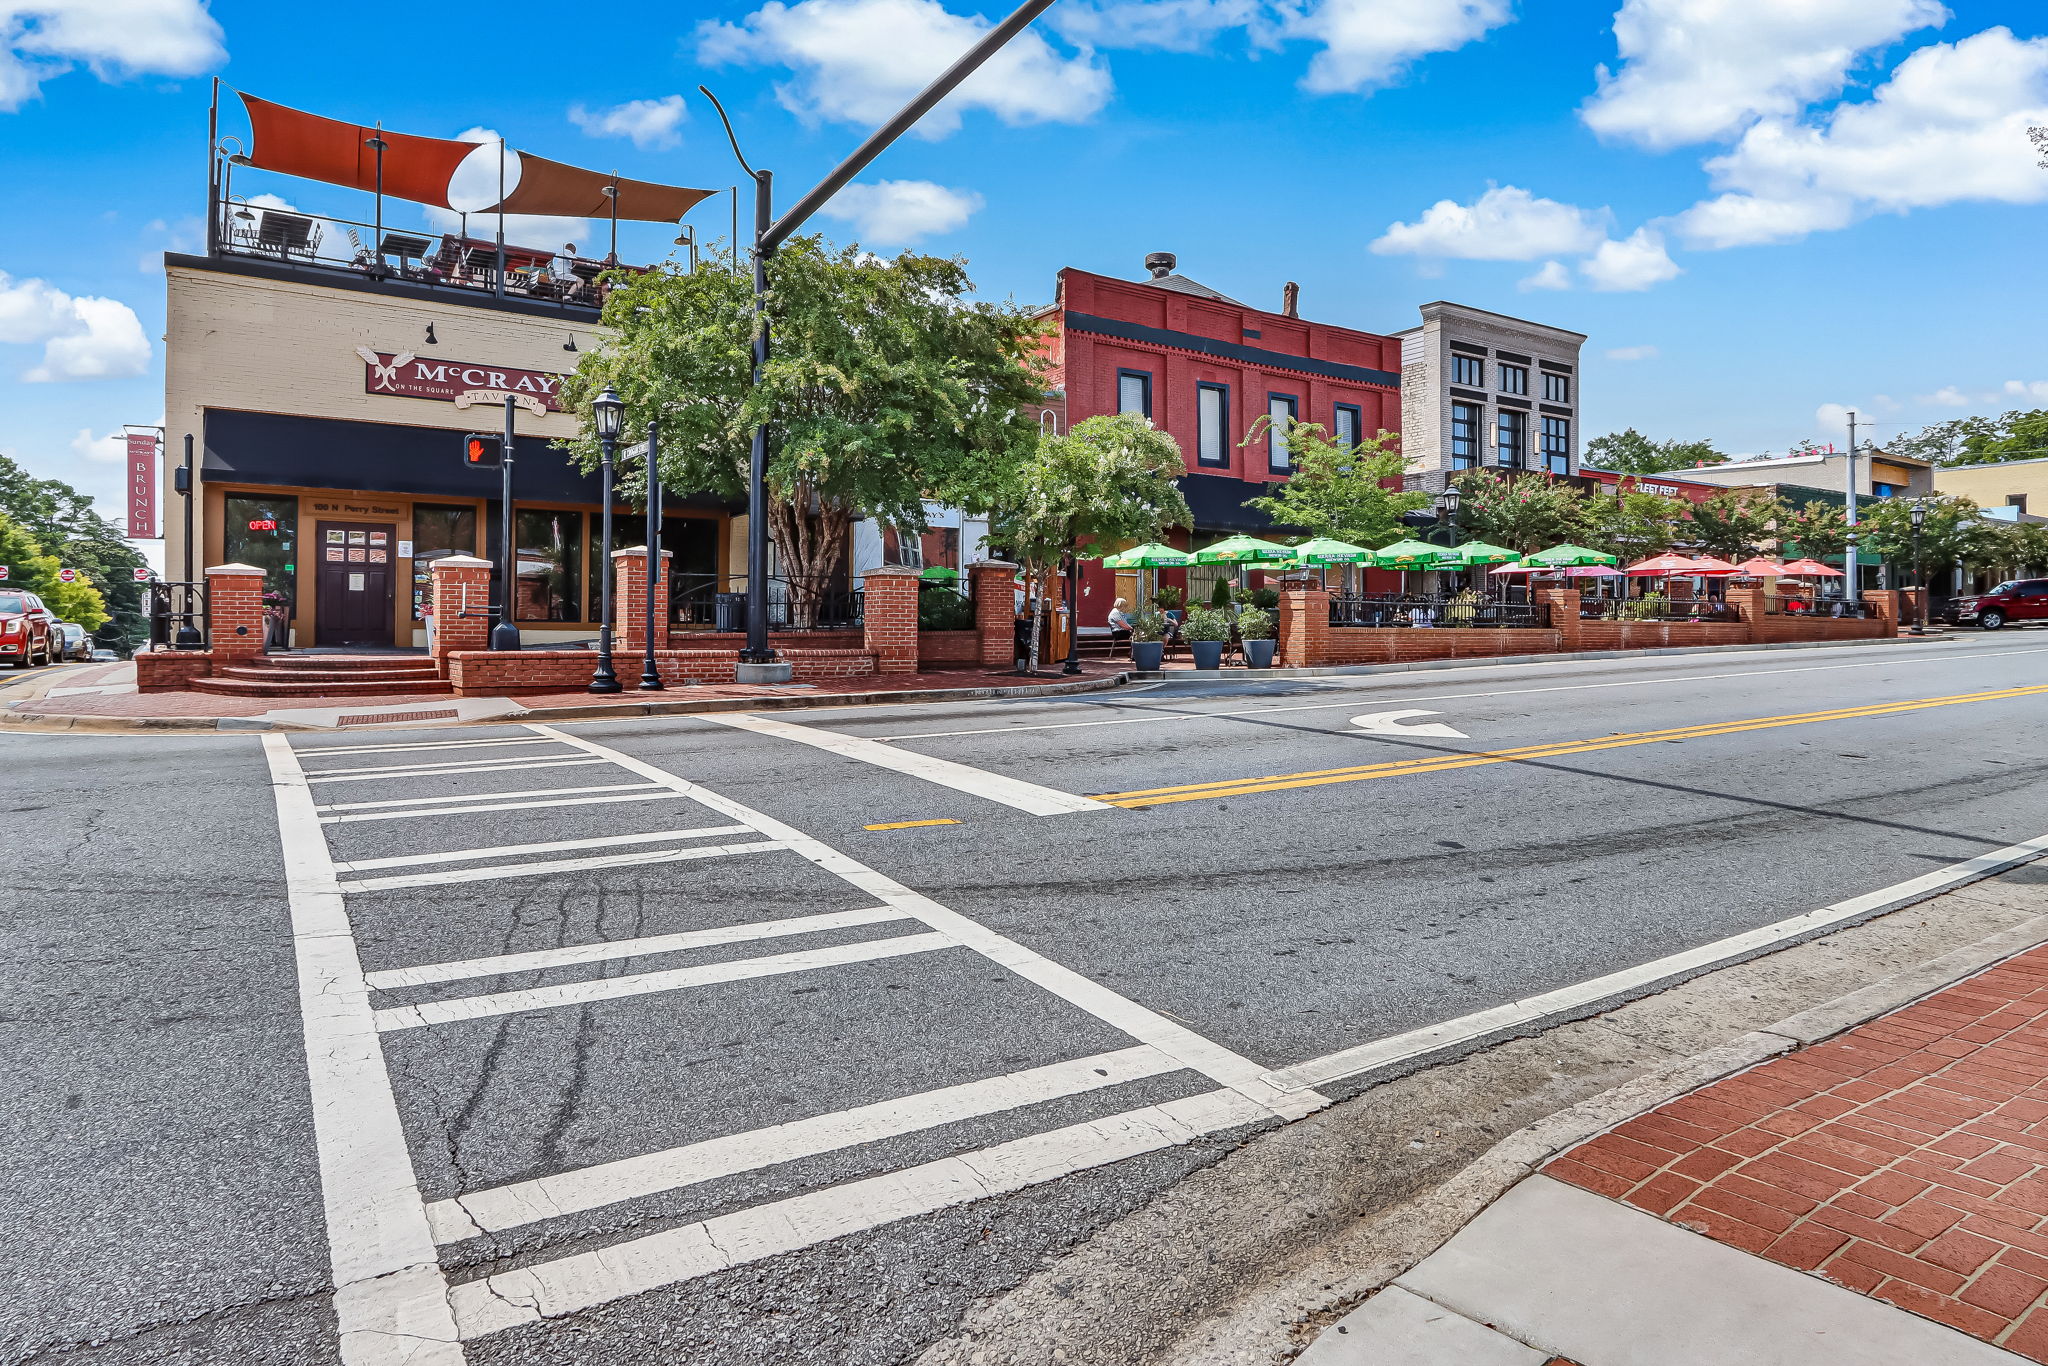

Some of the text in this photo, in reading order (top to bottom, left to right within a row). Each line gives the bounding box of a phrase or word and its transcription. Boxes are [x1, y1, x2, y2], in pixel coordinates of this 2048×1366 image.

[426, 386, 454, 395] SQUARE
[128, 439, 155, 447] Sunday
[1659, 485, 1679, 497] FEET
[135, 462, 148, 531] BRUNCH
[344, 504, 369, 514] Perry
[372, 506, 400, 515] Street
[249, 521, 276, 531] OPEN
